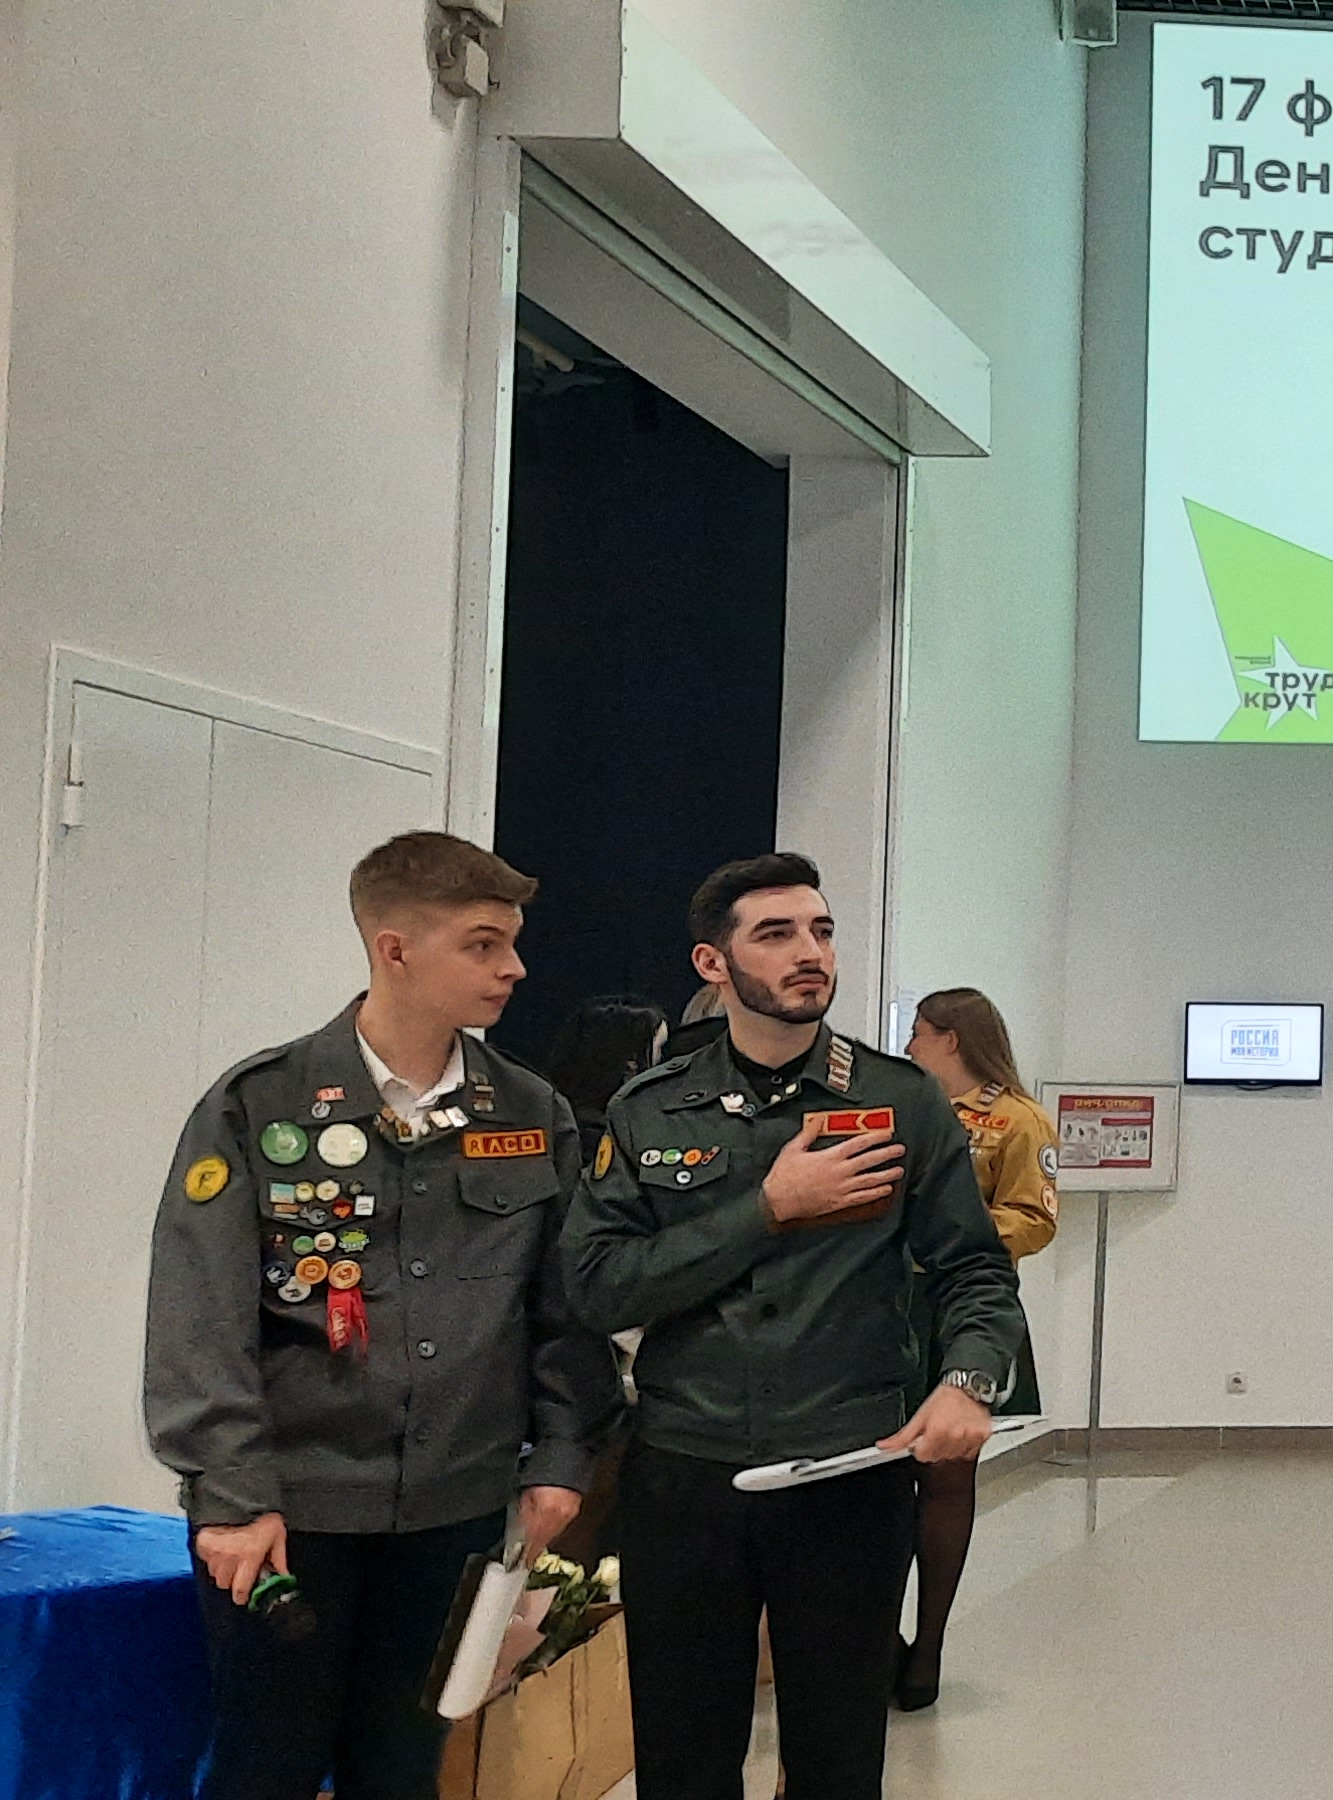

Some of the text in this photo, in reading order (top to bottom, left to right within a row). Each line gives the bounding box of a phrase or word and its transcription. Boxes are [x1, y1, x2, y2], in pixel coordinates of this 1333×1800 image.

[1199, 75, 1266, 122] 17
[1243, 691, 1317, 711] крут
[1231, 1029, 1279, 1046] РОССИЯ
